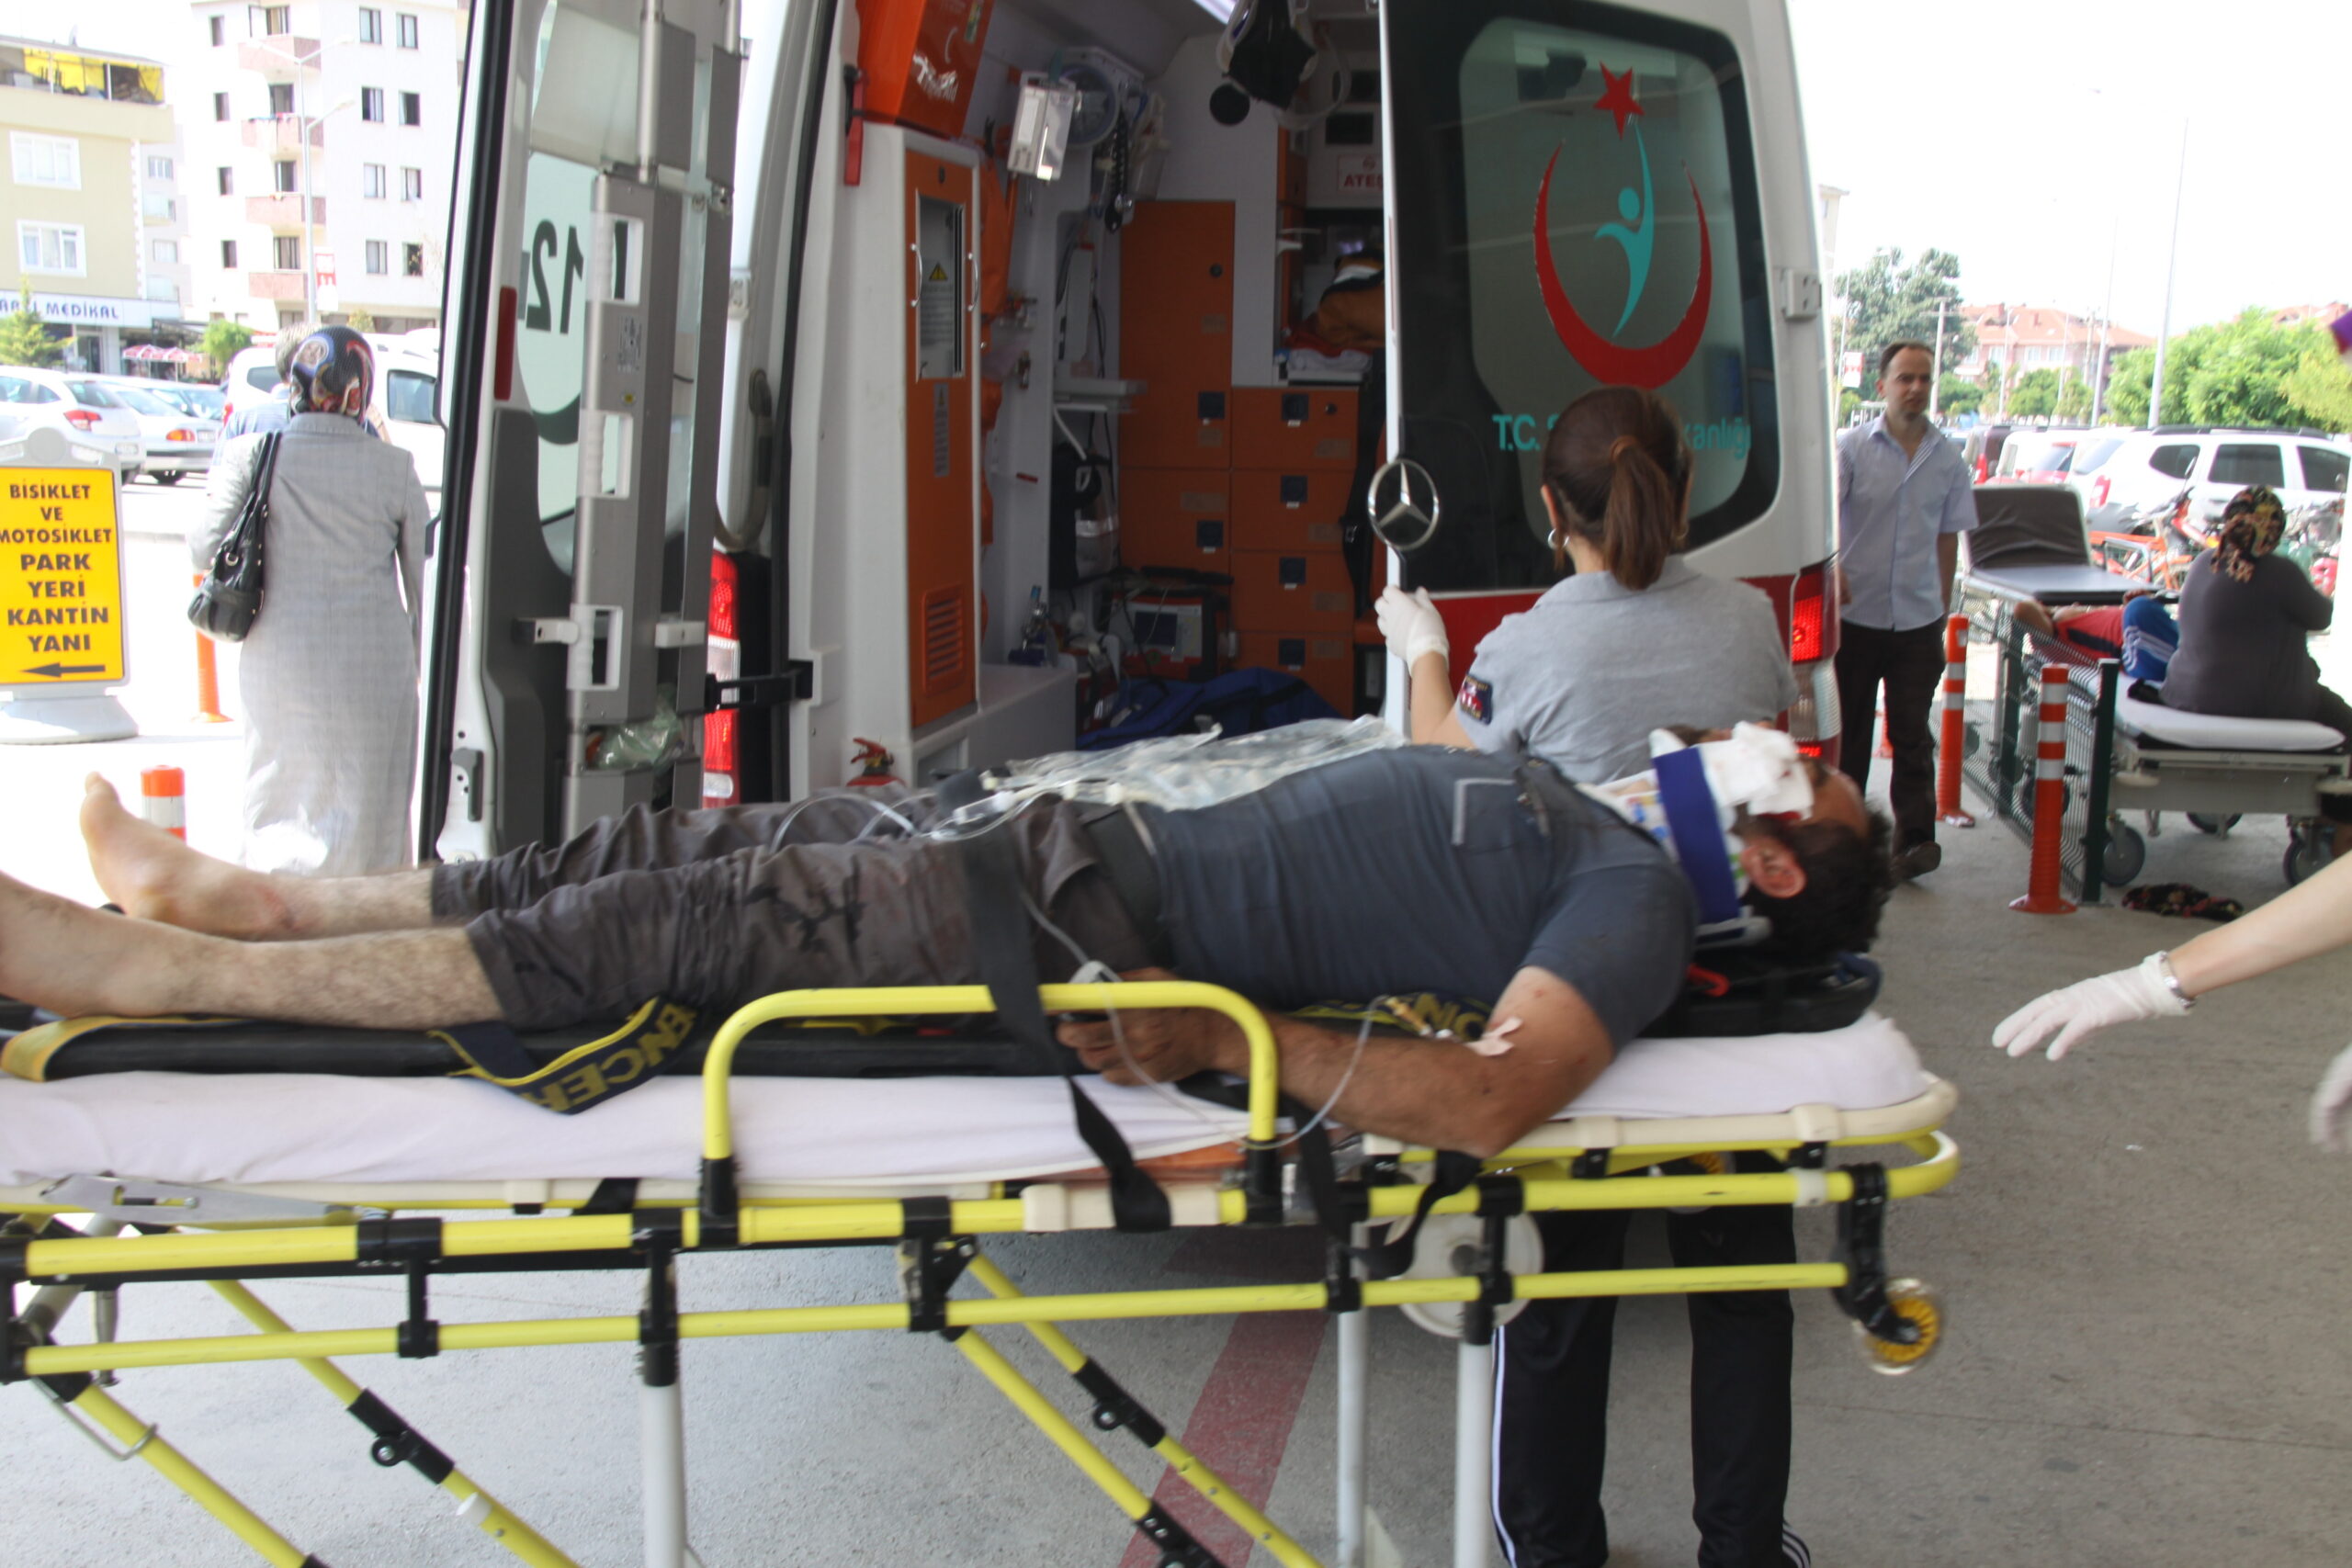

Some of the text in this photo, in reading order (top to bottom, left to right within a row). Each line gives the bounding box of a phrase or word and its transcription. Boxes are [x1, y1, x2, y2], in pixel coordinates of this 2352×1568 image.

[1492, 414, 1541, 451] T.C.
[9, 479, 91, 499] BİSİKLET
[40, 506, 63, 522] VE
[0, 524, 112, 544] MOTOSİKLET
[20, 553, 91, 570] PARK
[28, 573, 85, 598] YERİ
[7, 601, 108, 626] KANTİN
[28, 634, 91, 652] YANI
